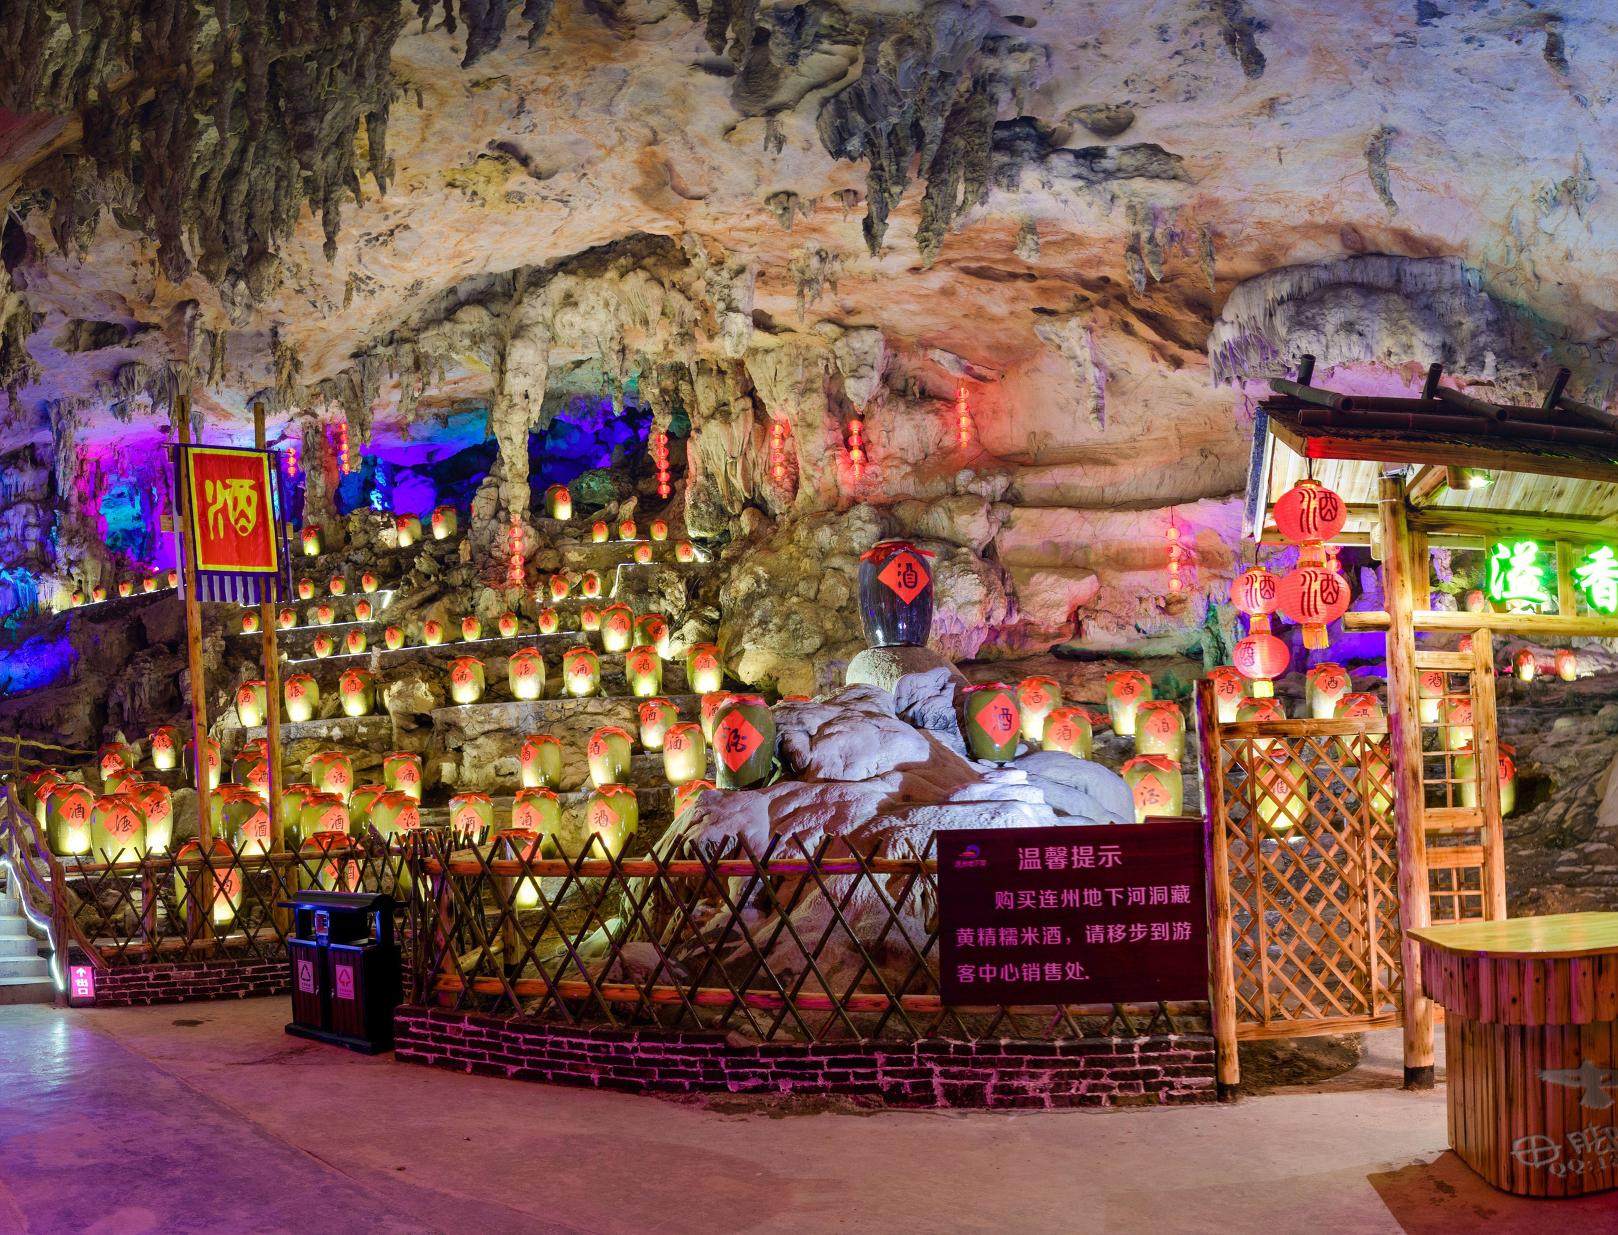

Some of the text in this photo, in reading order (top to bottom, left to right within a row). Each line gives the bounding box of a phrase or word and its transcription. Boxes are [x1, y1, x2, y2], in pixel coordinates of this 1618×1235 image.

[205, 479, 258, 540] 酒
[1298, 488, 1338, 533] 酒
[897, 562, 918, 588] 酒
[1245, 573, 1275, 609] 酒
[1301, 570, 1339, 617] 酒
[992, 704, 1013, 732] 酒
[1056, 725, 1073, 740] 酒
[69, 803, 85, 819] 酒
[115, 814, 131, 833] 酒
[331, 814, 344, 831] 酒
[519, 811, 533, 826] 酒
[594, 809, 609, 827] 酒
[254, 820, 267, 837] 酒
[1018, 845, 1122, 871] 温馨提示
[994, 885, 1191, 910] 购买连州地下河洞藏
[955, 922, 1192, 947] 黄精糯米酒，请移步到游
[75, 978, 88, 995] 出口
